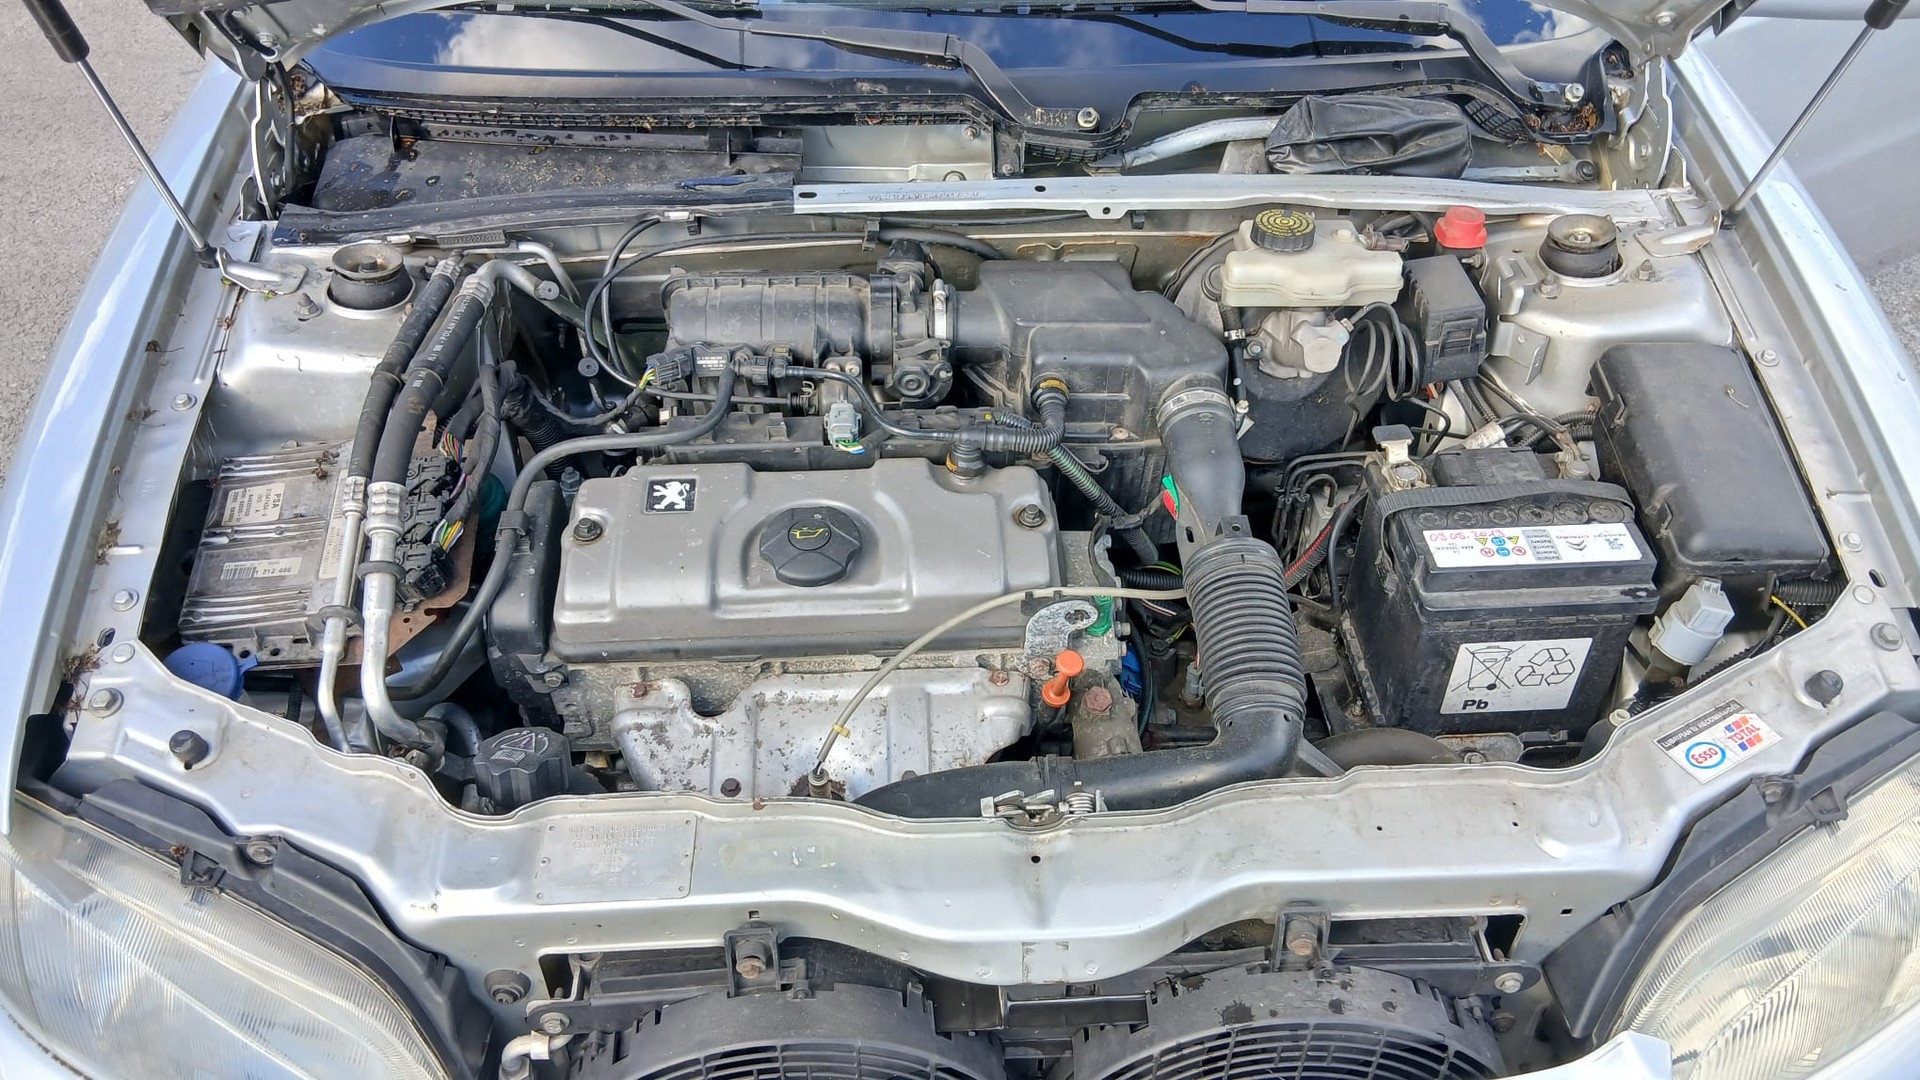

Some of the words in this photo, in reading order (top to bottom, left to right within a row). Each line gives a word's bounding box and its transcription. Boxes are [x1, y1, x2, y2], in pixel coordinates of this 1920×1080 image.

[272, 493, 281, 508] PSA
[1462, 699, 1489, 710] Pb
[1727, 724, 1760, 743] TOTAL
